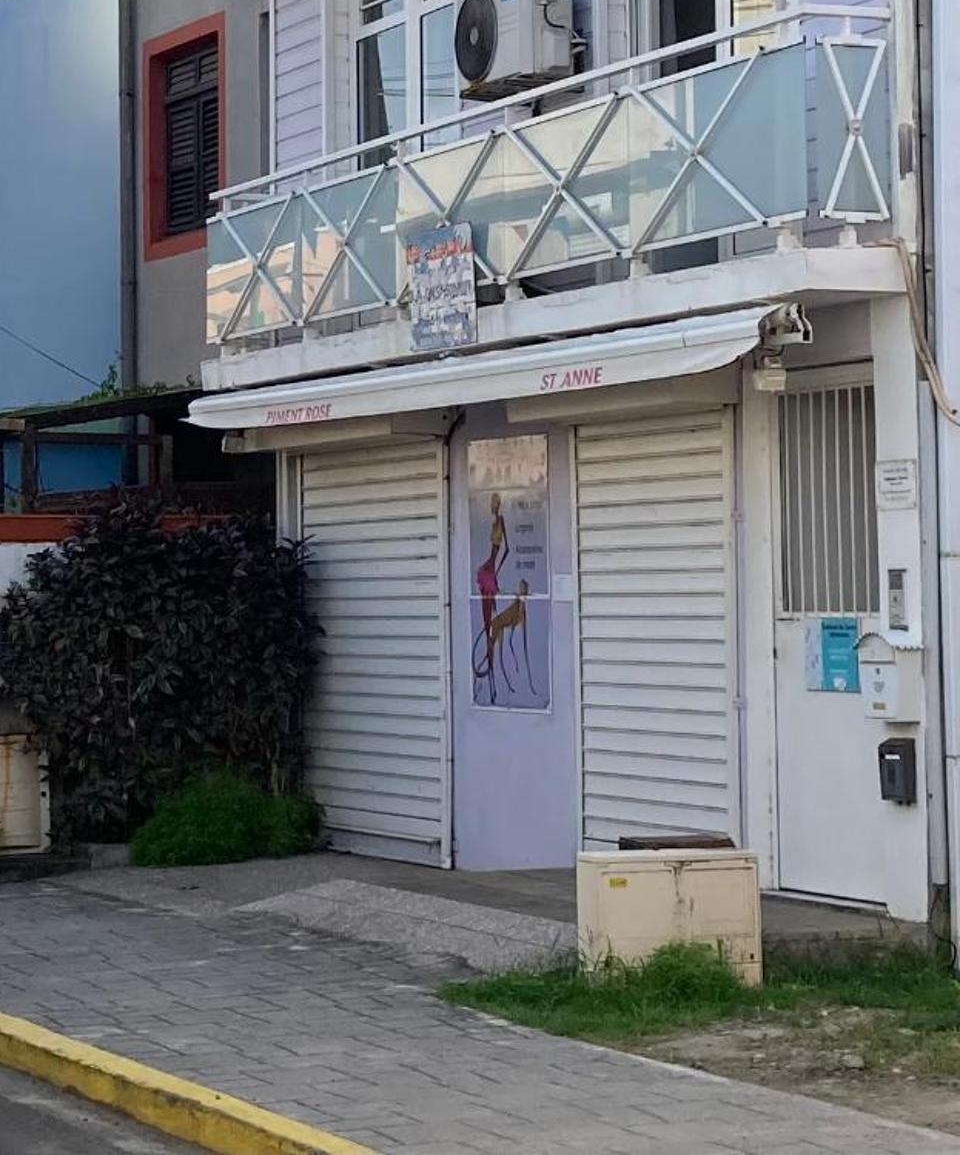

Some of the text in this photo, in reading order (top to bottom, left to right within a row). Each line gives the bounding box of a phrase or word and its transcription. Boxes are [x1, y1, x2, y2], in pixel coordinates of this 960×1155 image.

[541, 367, 603, 390] ST ANNE
[265, 404, 332, 423] PIMENT ROSE
